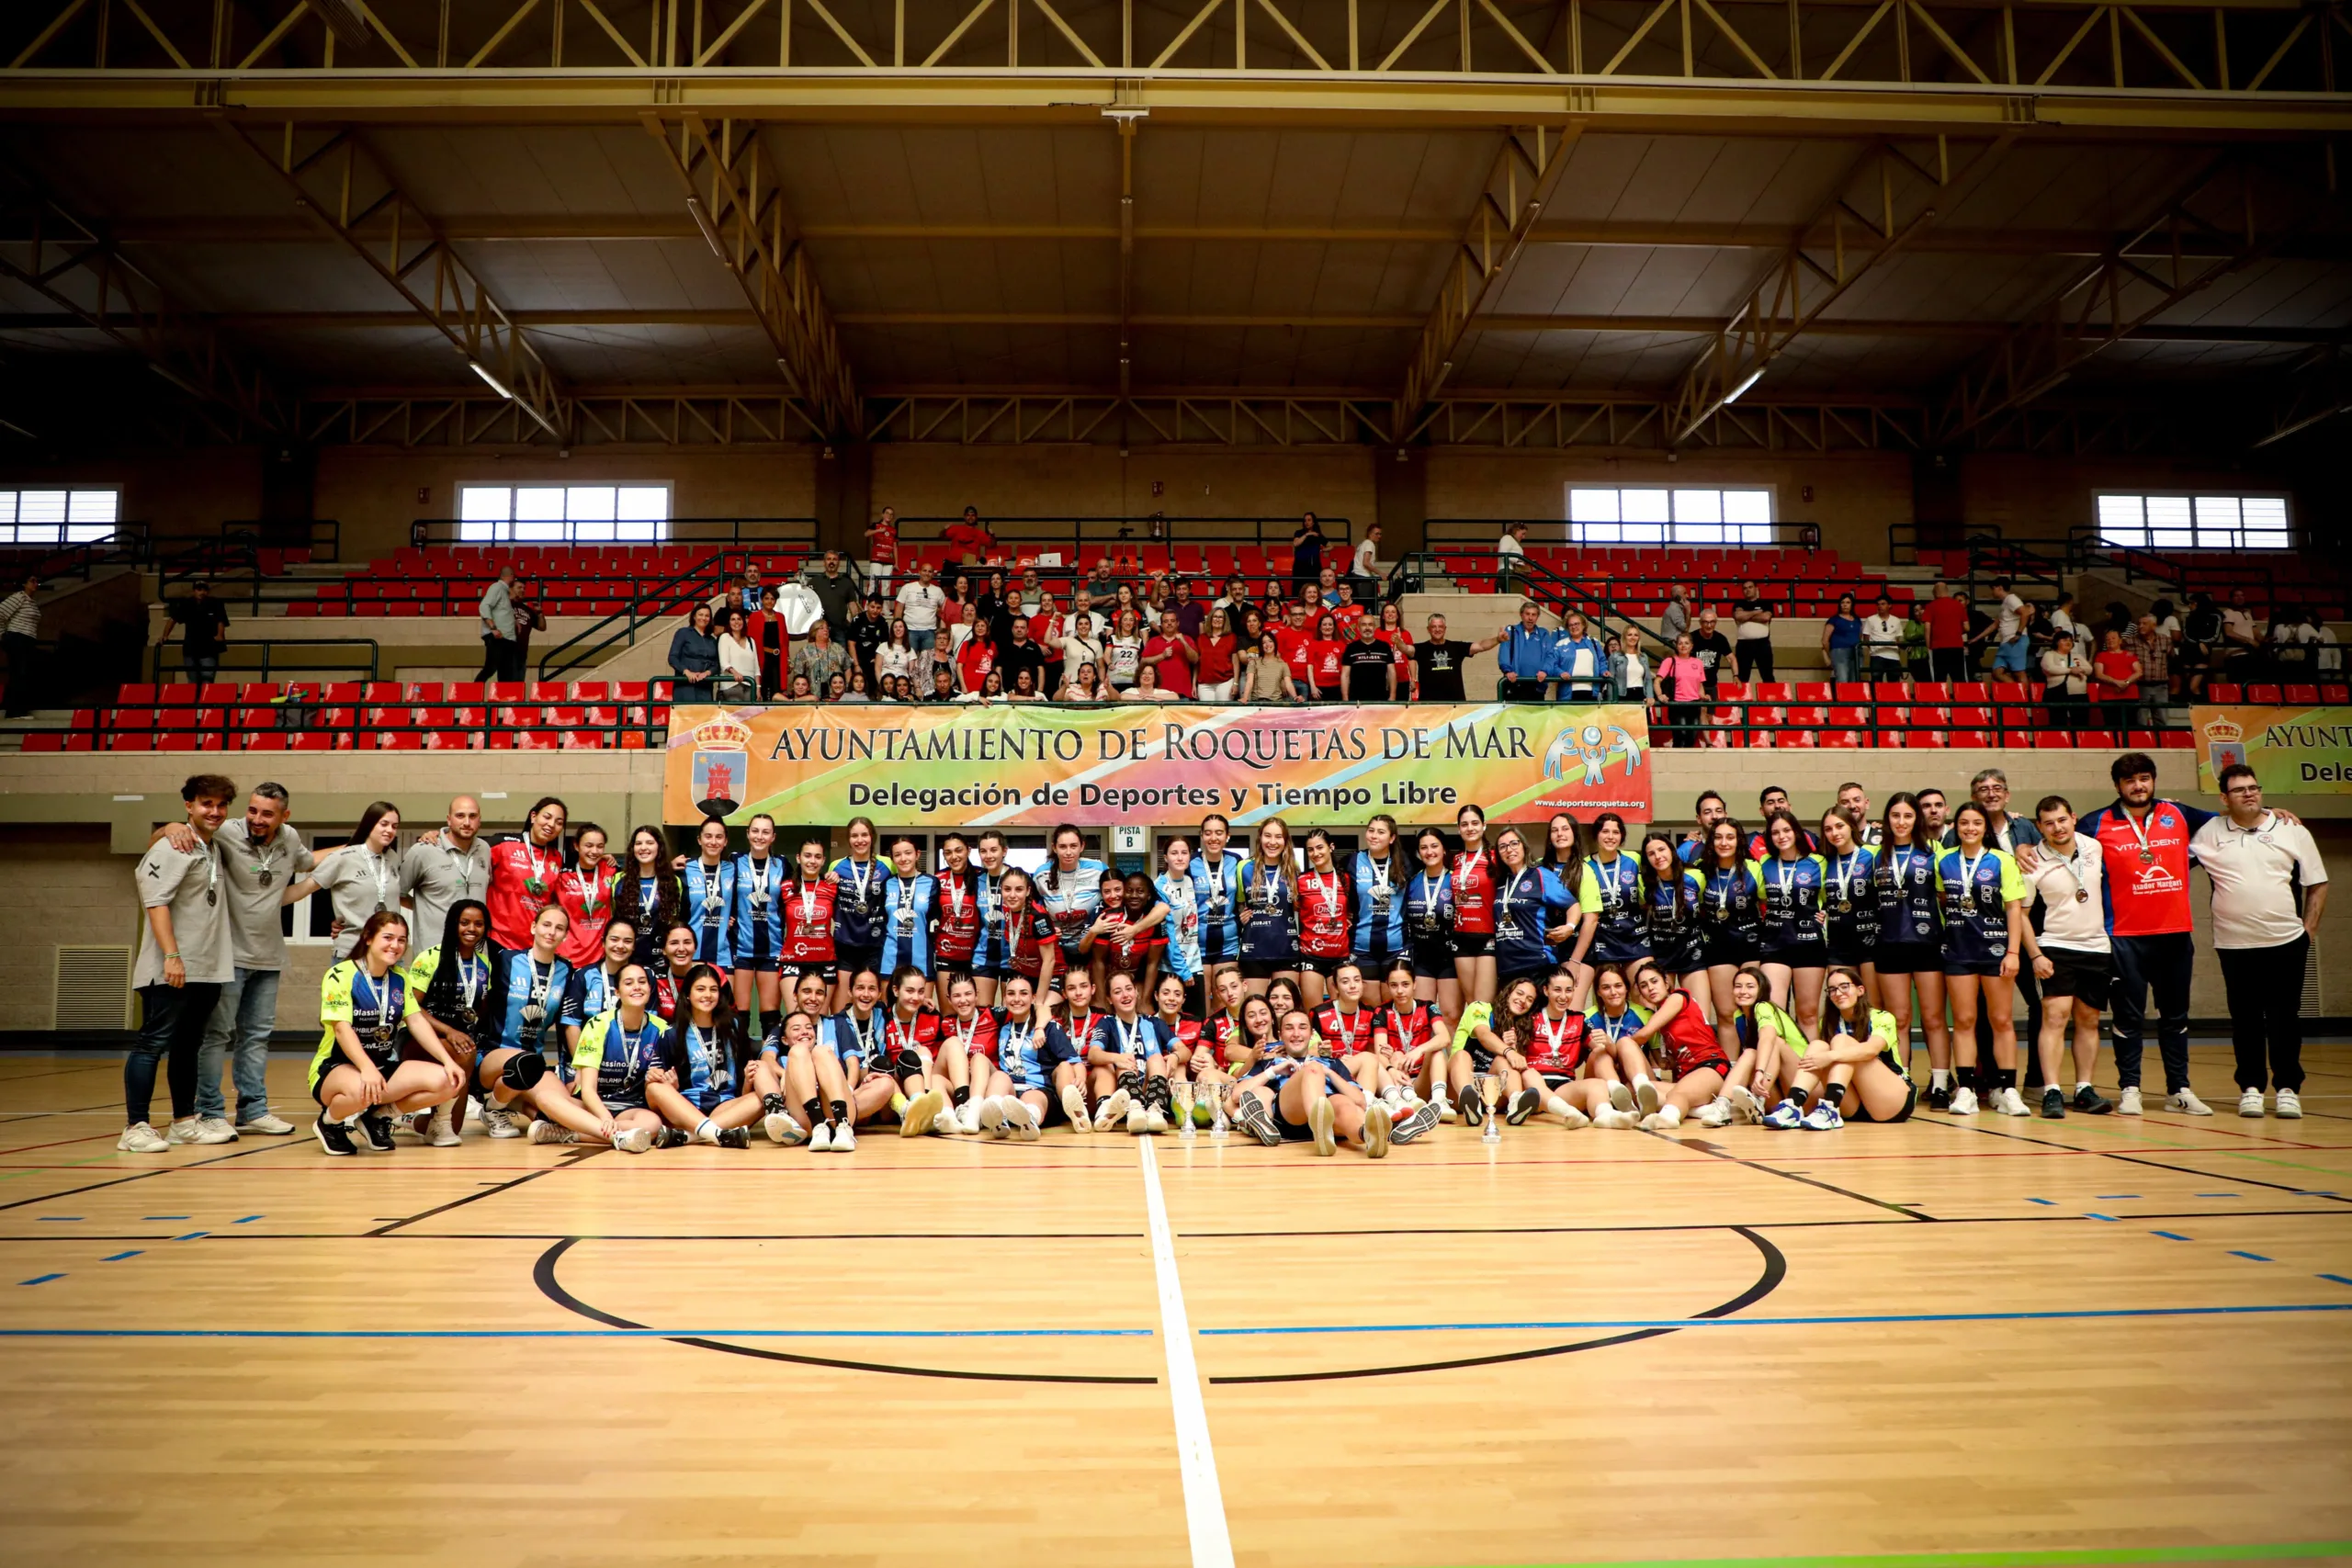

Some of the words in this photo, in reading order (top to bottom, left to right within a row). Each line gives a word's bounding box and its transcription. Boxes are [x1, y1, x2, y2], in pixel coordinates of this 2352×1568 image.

[1120, 650, 1132, 658] 22
[769, 727, 1083, 761] AYUNTAMIENTO
[1097, 728, 1147, 760] DE
[1162, 722, 1365, 769] ROQUETAS
[1381, 727, 1431, 760] DE
[1444, 721, 1534, 759] MAR
[849, 782, 1021, 813] Delegación
[1031, 782, 1069, 806] de
[1080, 783, 1220, 812] Deportes
[1230, 787, 1247, 812] y
[1258, 783, 1372, 812] Tiempo
[1382, 781, 1457, 805] Libre
[1534, 799, 1646, 810] www.deportesroquetas.org
[1119, 826, 1141, 835] PISTA
[1126, 836, 1133, 847] B
[782, 964, 800, 976] 24
